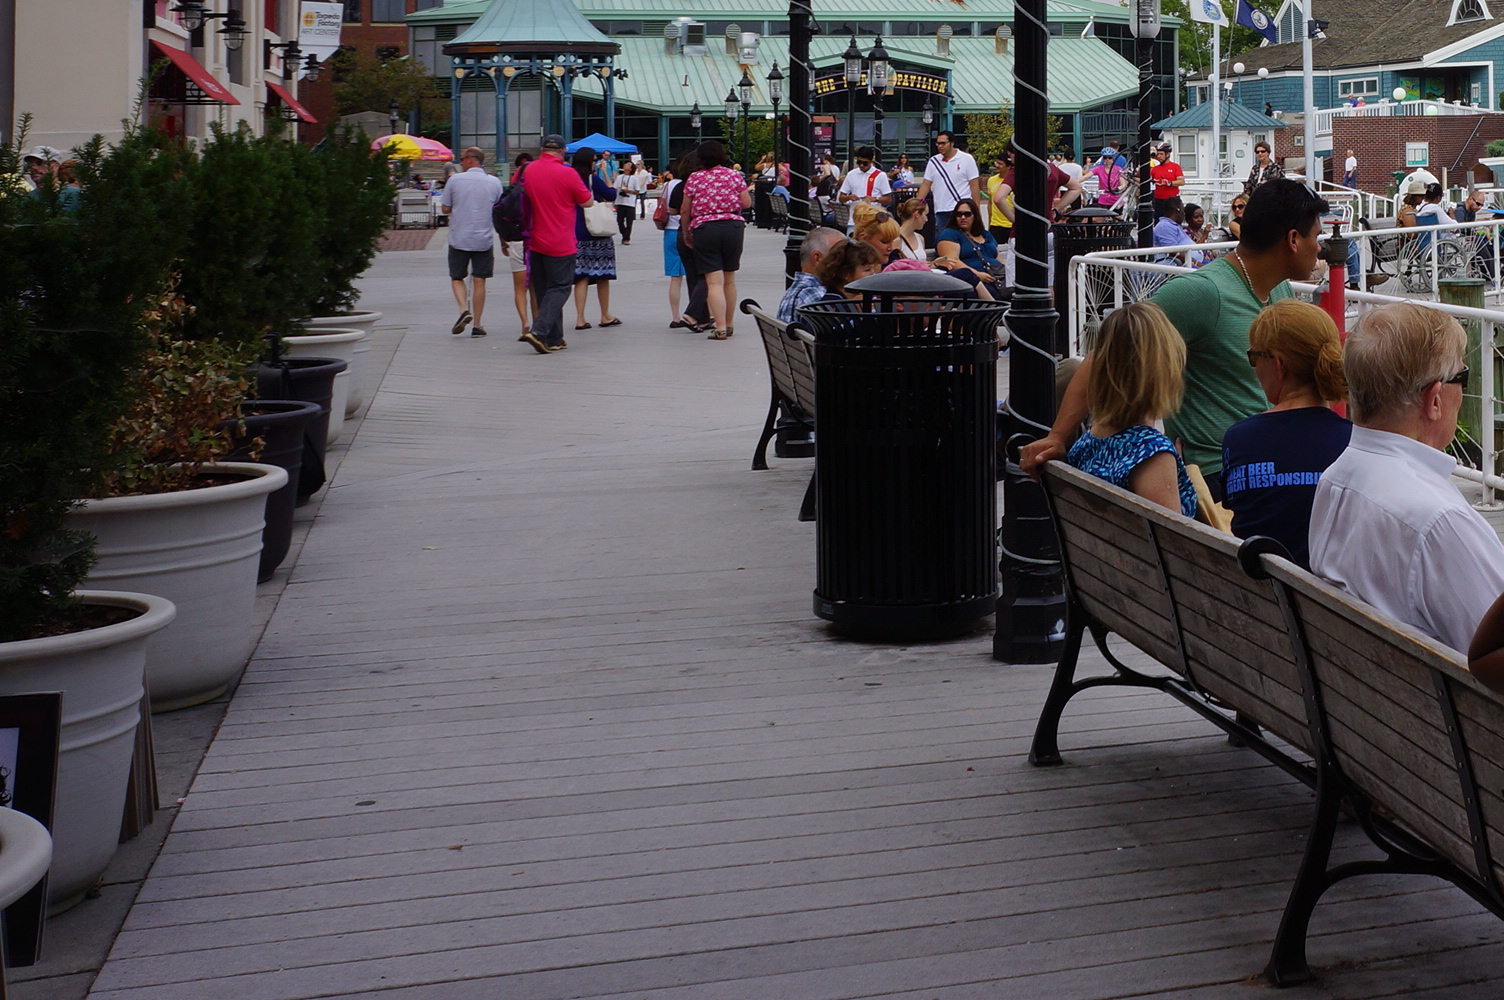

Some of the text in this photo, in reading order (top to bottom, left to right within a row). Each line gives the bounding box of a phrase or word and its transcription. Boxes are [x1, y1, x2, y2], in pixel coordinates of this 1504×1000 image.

[815, 78, 836, 94] THE
[896, 73, 947, 94] PAVILION
[1248, 461, 1275, 477] BEER
[1248, 472, 1322, 489] RESPONSIBI
